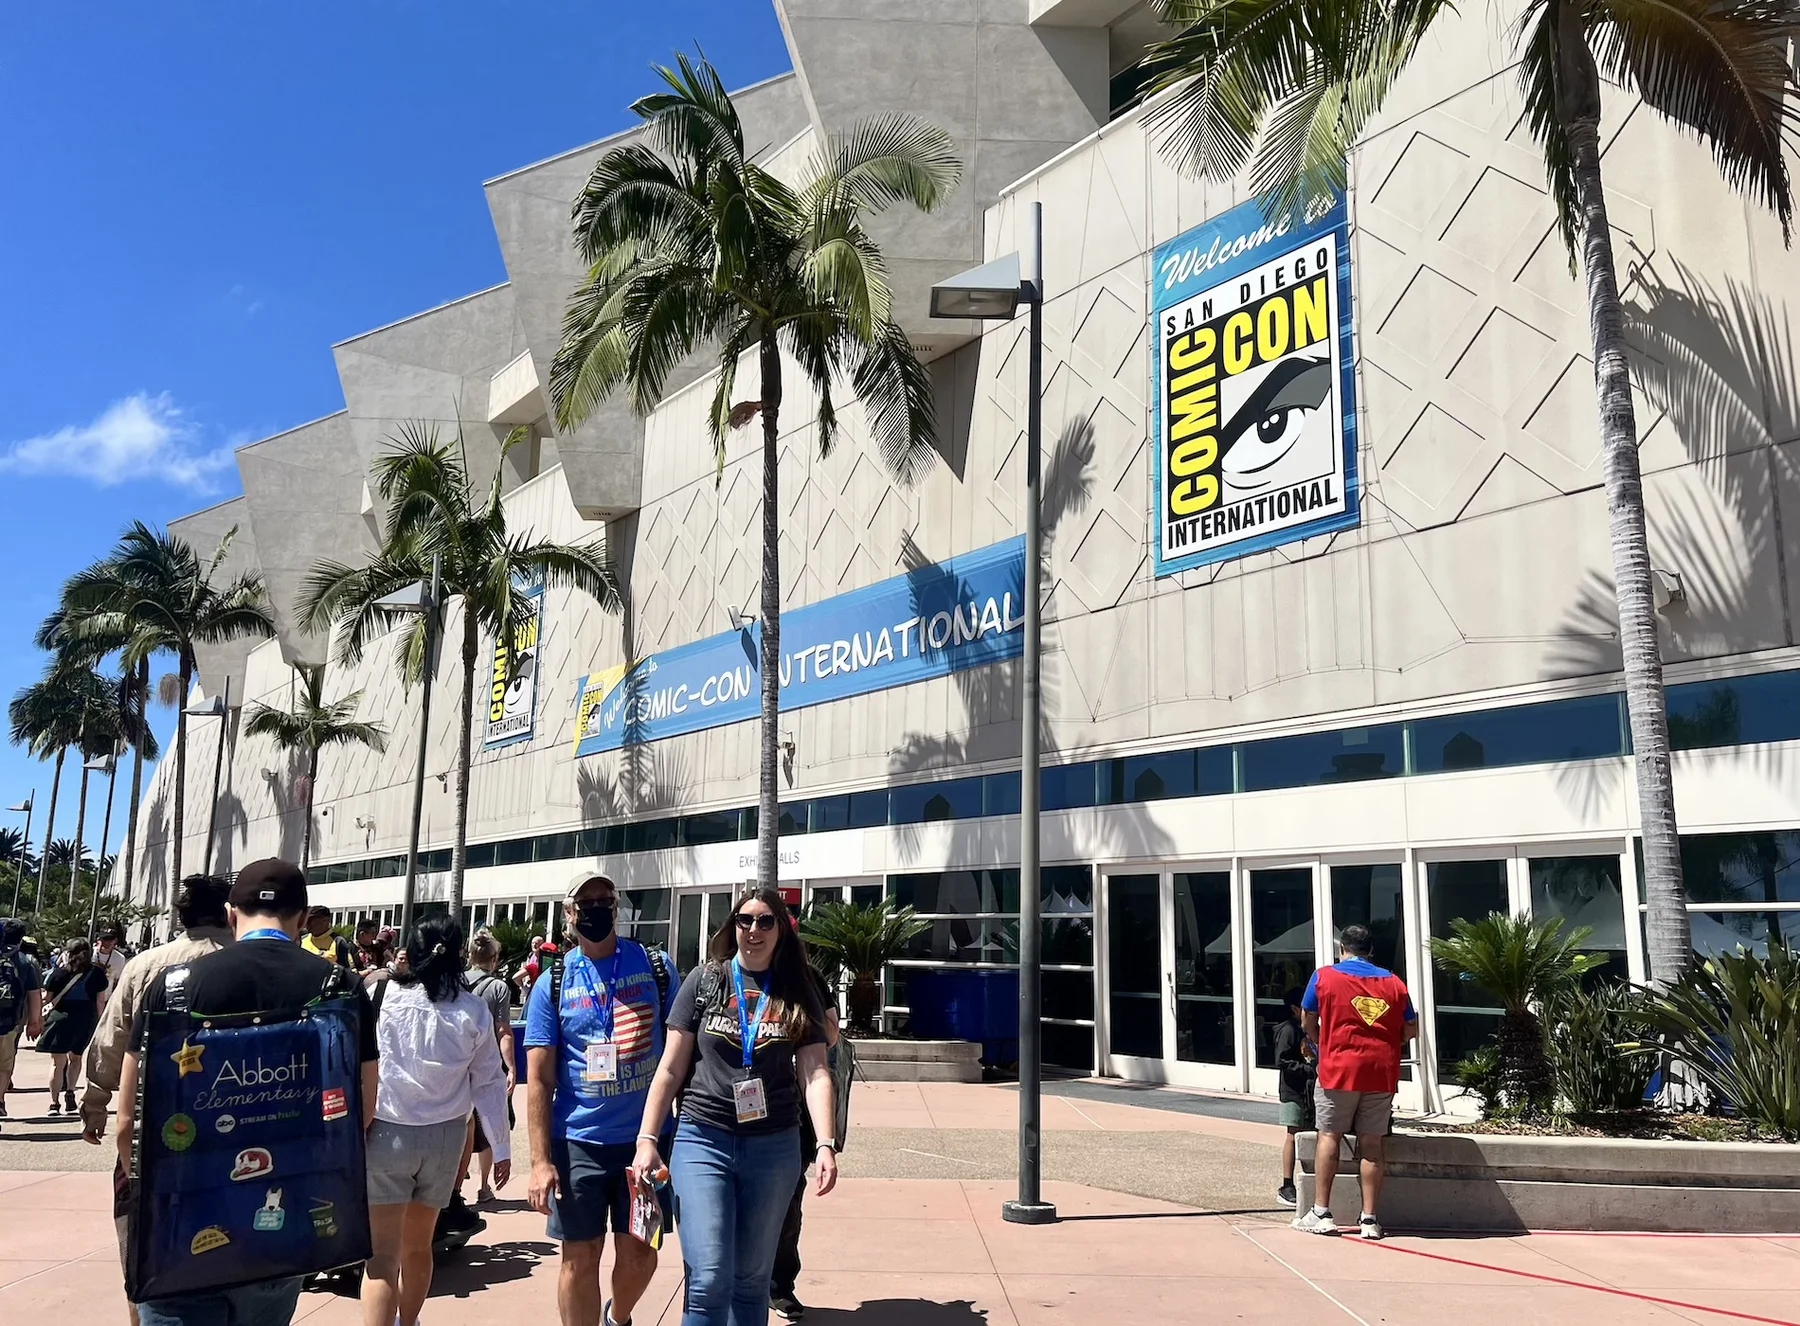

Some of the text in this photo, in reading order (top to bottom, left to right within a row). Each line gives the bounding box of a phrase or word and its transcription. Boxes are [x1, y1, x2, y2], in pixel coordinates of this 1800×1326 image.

[1162, 210, 1292, 291] Welcome
[1166, 246, 1329, 336] SAN DIEGO
[1222, 277, 1329, 377] CON
[1168, 326, 1220, 517] COMIC
[1168, 478, 1339, 550] INTERNATIONAL
[779, 591, 1025, 688] NTERNATIONAL
[779, 851, 800, 864] ALLS
[193, 1084, 320, 1111] Elementary
[211, 1052, 308, 1090] Abbott
[602, 1074, 646, 1097] THE LAW
[620, 1064, 632, 1079] IS
[217, 1119, 234, 1128] abc
[240, 1115, 267, 1125] STREAM
[278, 1109, 300, 1120] hulu
